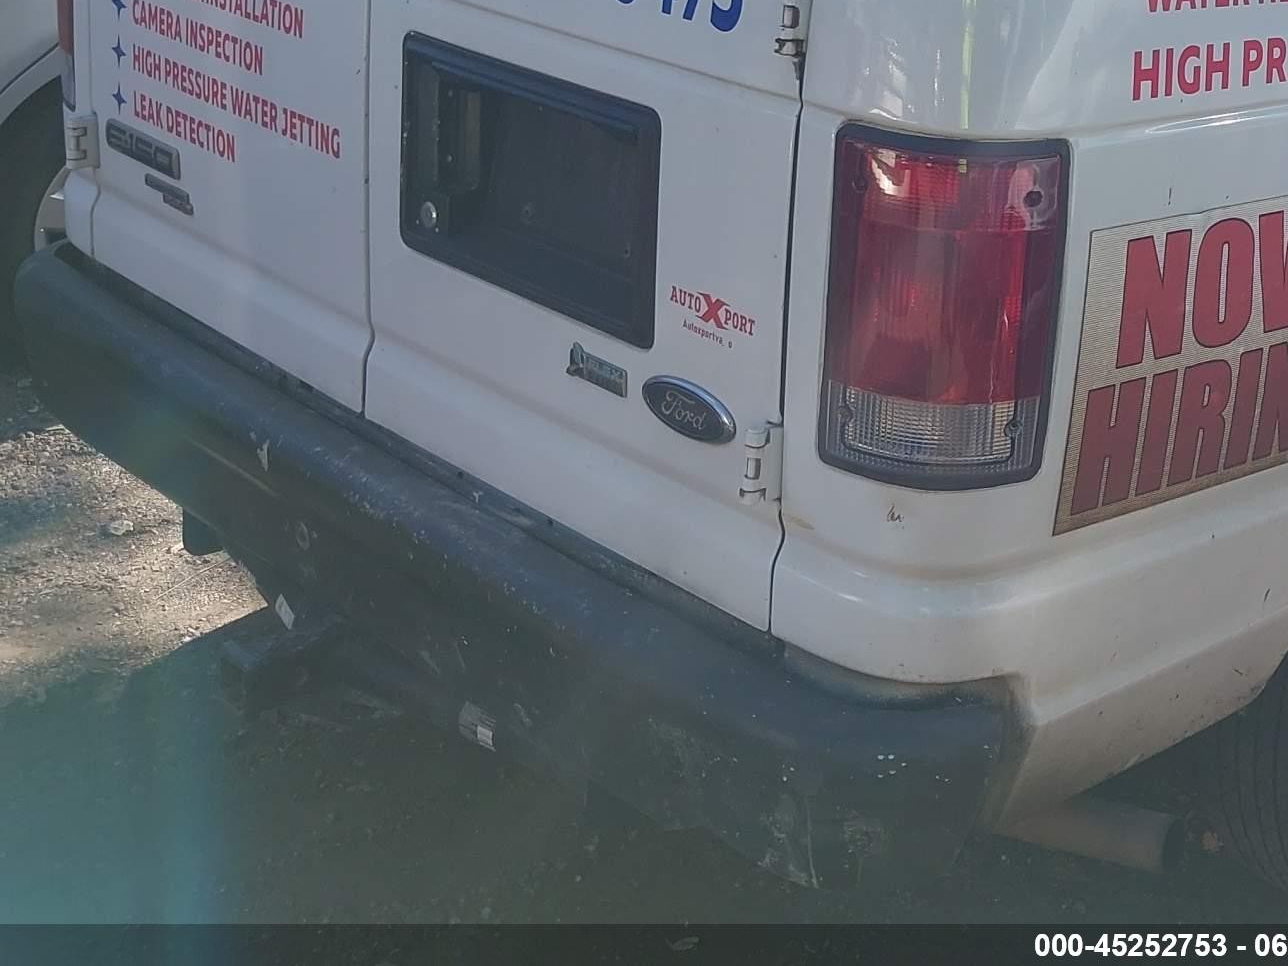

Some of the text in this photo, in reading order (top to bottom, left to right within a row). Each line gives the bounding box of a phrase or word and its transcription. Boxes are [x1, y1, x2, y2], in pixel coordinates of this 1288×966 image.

[185, 18, 263, 76] INSPECTION
[1132, 44, 1229, 101] HIGH
[133, 44, 341, 159] HIGH PRESSURE WATER JETTING
[133, 90, 163, 129] LEAK
[166, 105, 236, 163] DETECTION
[660, 390, 707, 431] Ford
